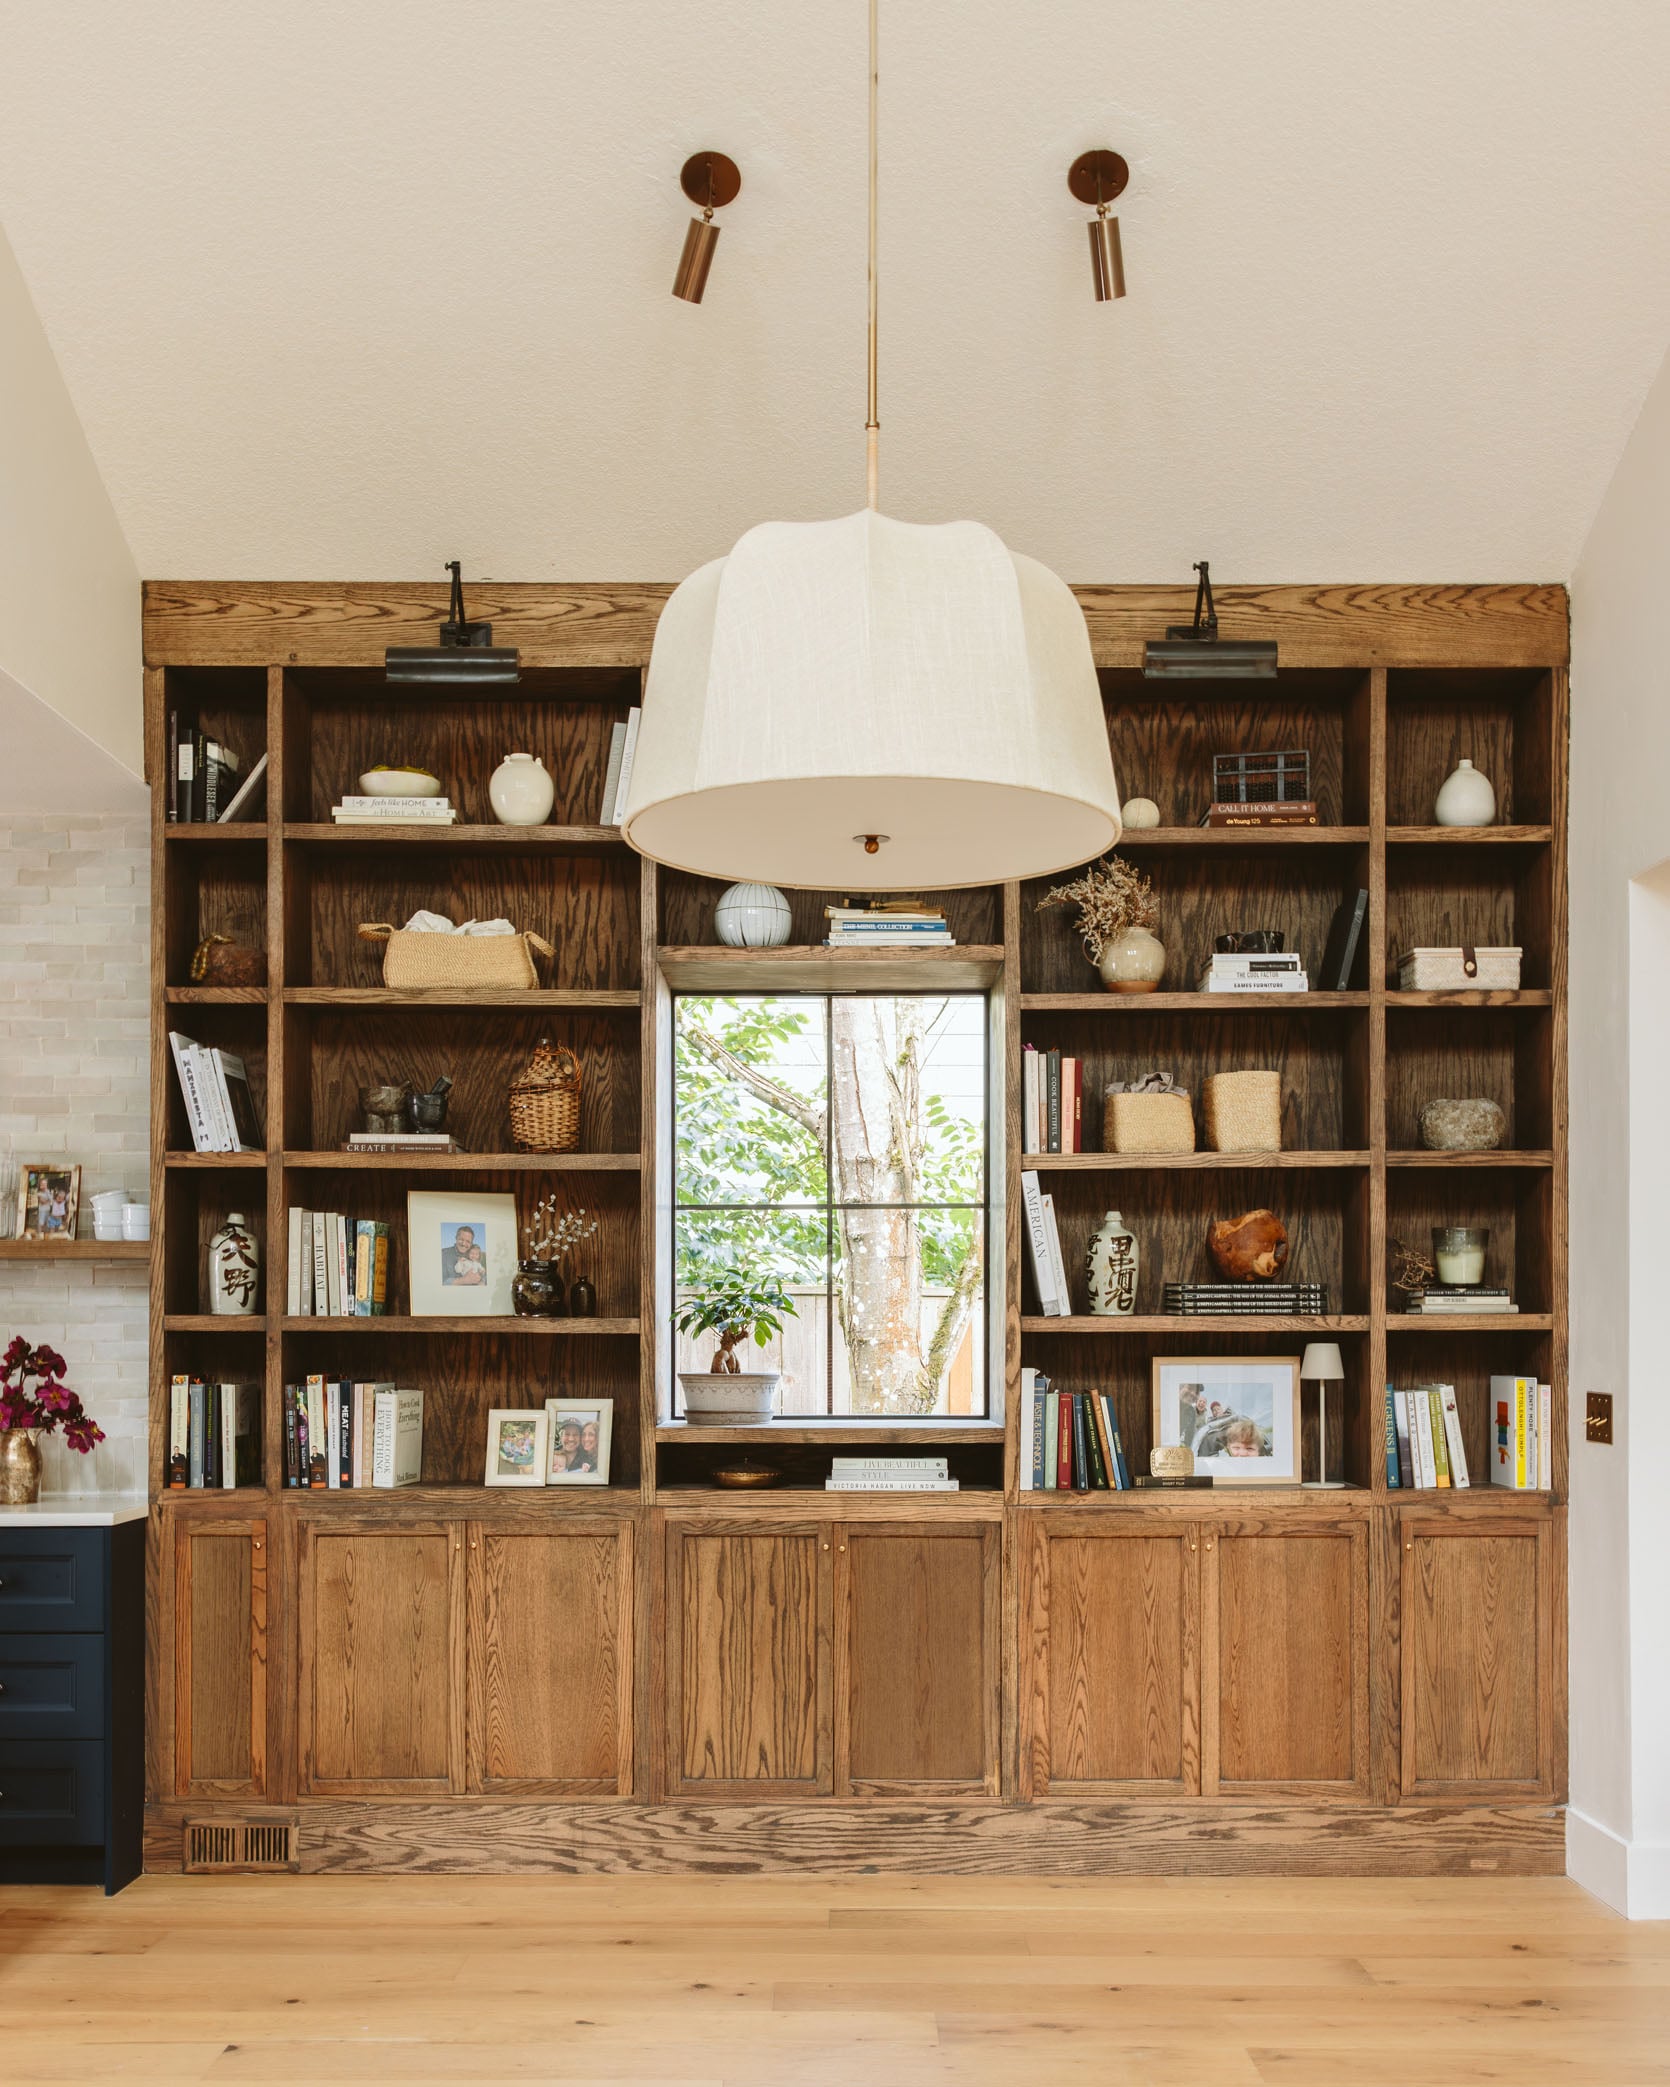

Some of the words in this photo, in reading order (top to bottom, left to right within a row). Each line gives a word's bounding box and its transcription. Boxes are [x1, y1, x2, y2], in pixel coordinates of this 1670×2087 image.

[371, 799, 386, 808] feels
[388, 799, 400, 808] like
[402, 800, 428, 808] HOME
[381, 808, 405, 816] HOME
[1218, 804, 1240, 812] CALL
[1251, 804, 1276, 812] HOME
[1026, 1186, 1047, 1258] AMERICAN
[316, 1245, 325, 1290] HABITAT
[376, 1410, 384, 1474] EVERYTHING
[385, 1434, 391, 1447] TO
[1386, 1405, 1394, 1446] GREENS
[1033, 1430, 1041, 1470] TECHNIQUE
